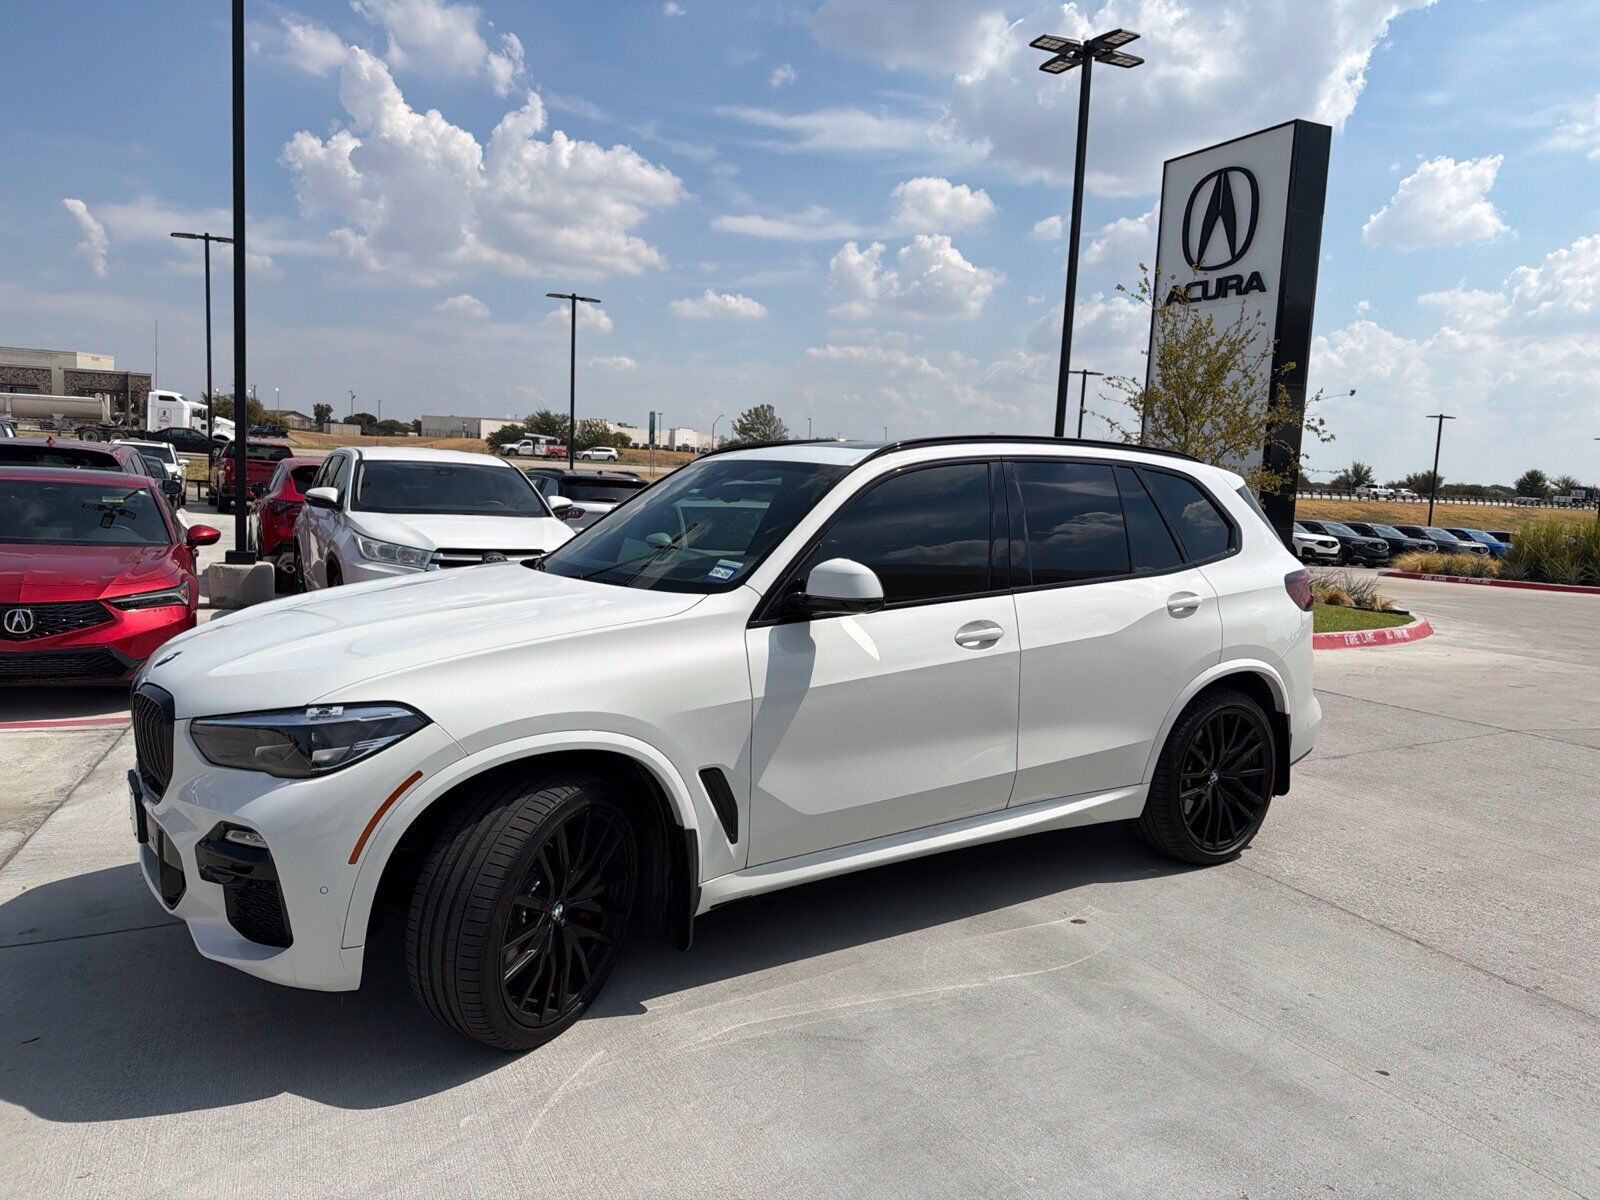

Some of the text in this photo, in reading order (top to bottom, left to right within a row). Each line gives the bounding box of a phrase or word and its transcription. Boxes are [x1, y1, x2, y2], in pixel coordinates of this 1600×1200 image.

[1166, 271, 1266, 305] ACURA
[1344, 633, 1360, 645] FIRE
[1360, 631, 1376, 643] LANE
